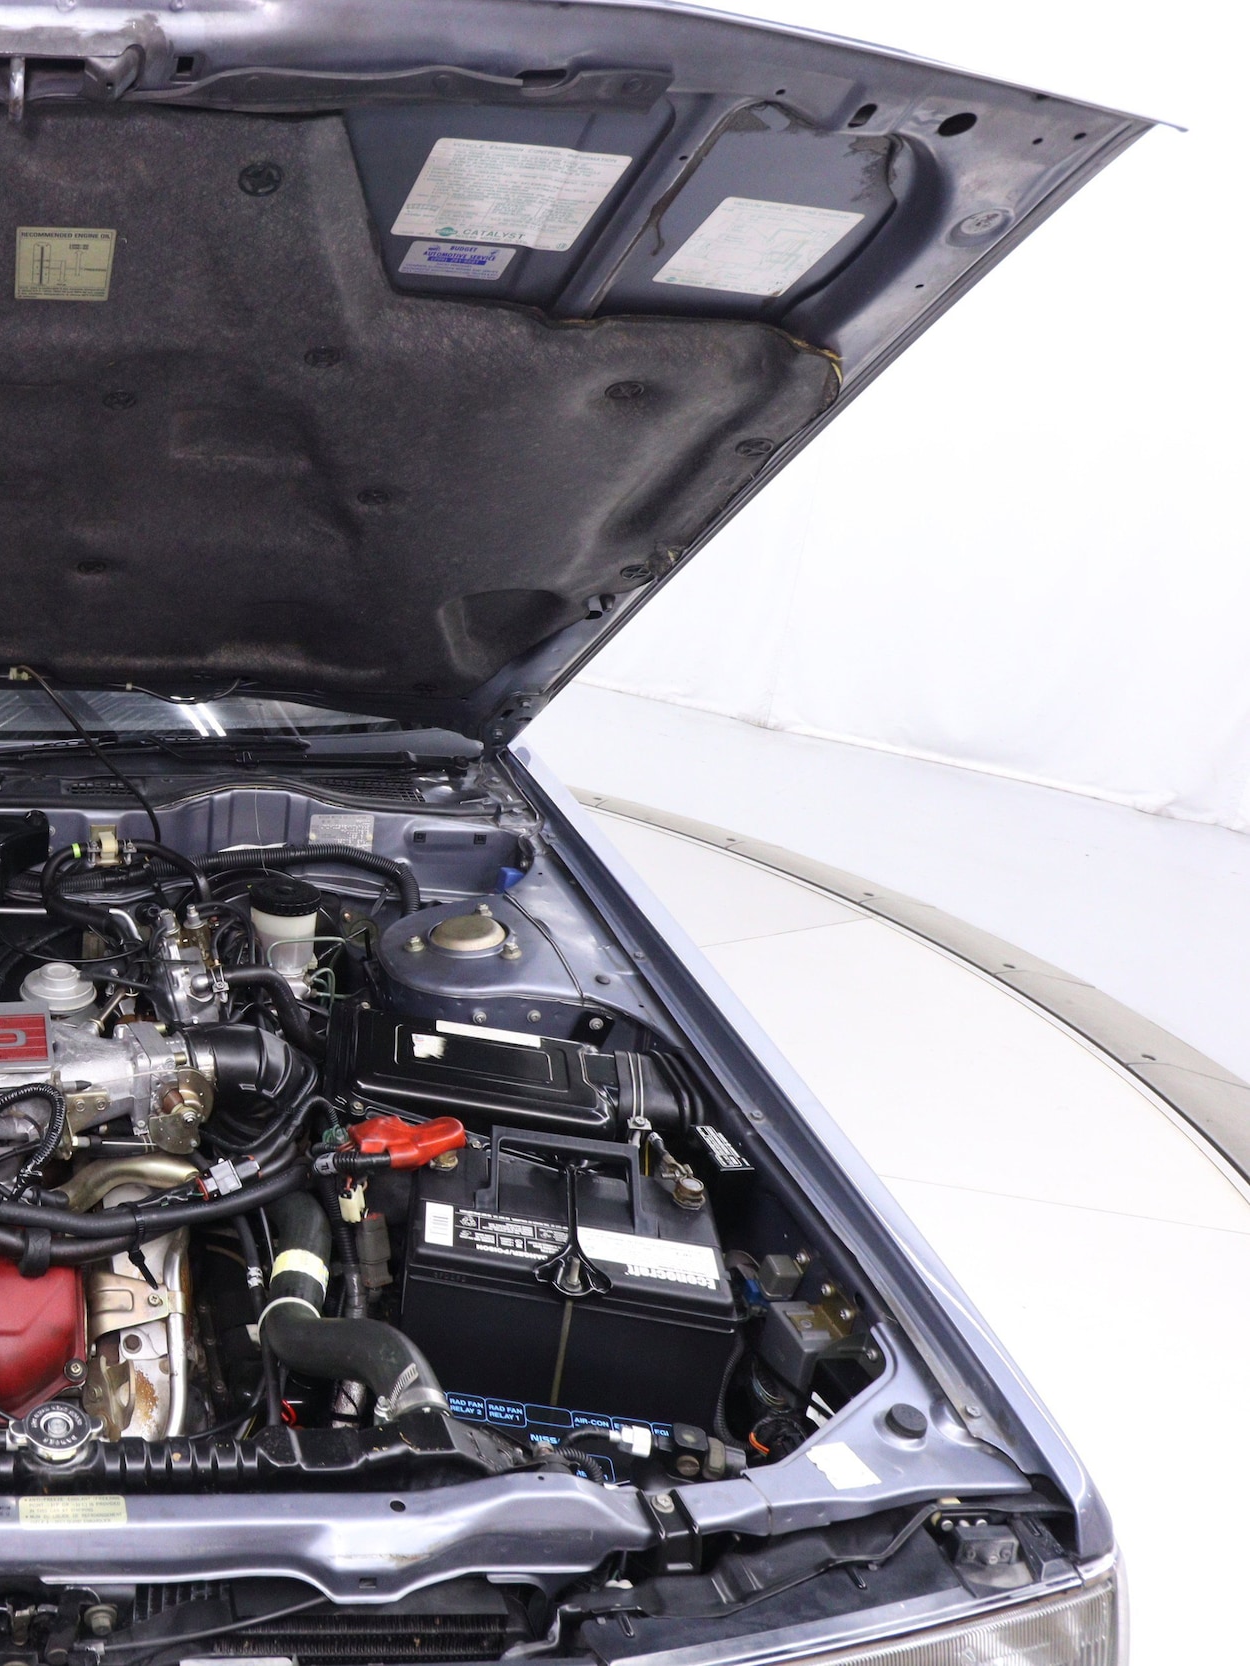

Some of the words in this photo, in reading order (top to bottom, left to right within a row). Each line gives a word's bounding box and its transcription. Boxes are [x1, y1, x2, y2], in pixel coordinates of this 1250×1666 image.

[21, 231, 73, 239] RECOMMENDED
[462, 229, 526, 240] CATALYST
[449, 245, 478, 253] BUDGET
[423, 251, 467, 259] AUTOMOTIVE
[469, 253, 496, 262] SERVICE
[448, 1398, 467, 1408] RAD
[468, 1400, 484, 1409] FAN
[487, 1403, 506, 1413] RAD
[506, 1405, 523, 1415] FAN
[449, 1405, 475, 1415] RELAY
[488, 1410, 514, 1421] RELAY
[574, 1417, 610, 1428] AIR-CON
